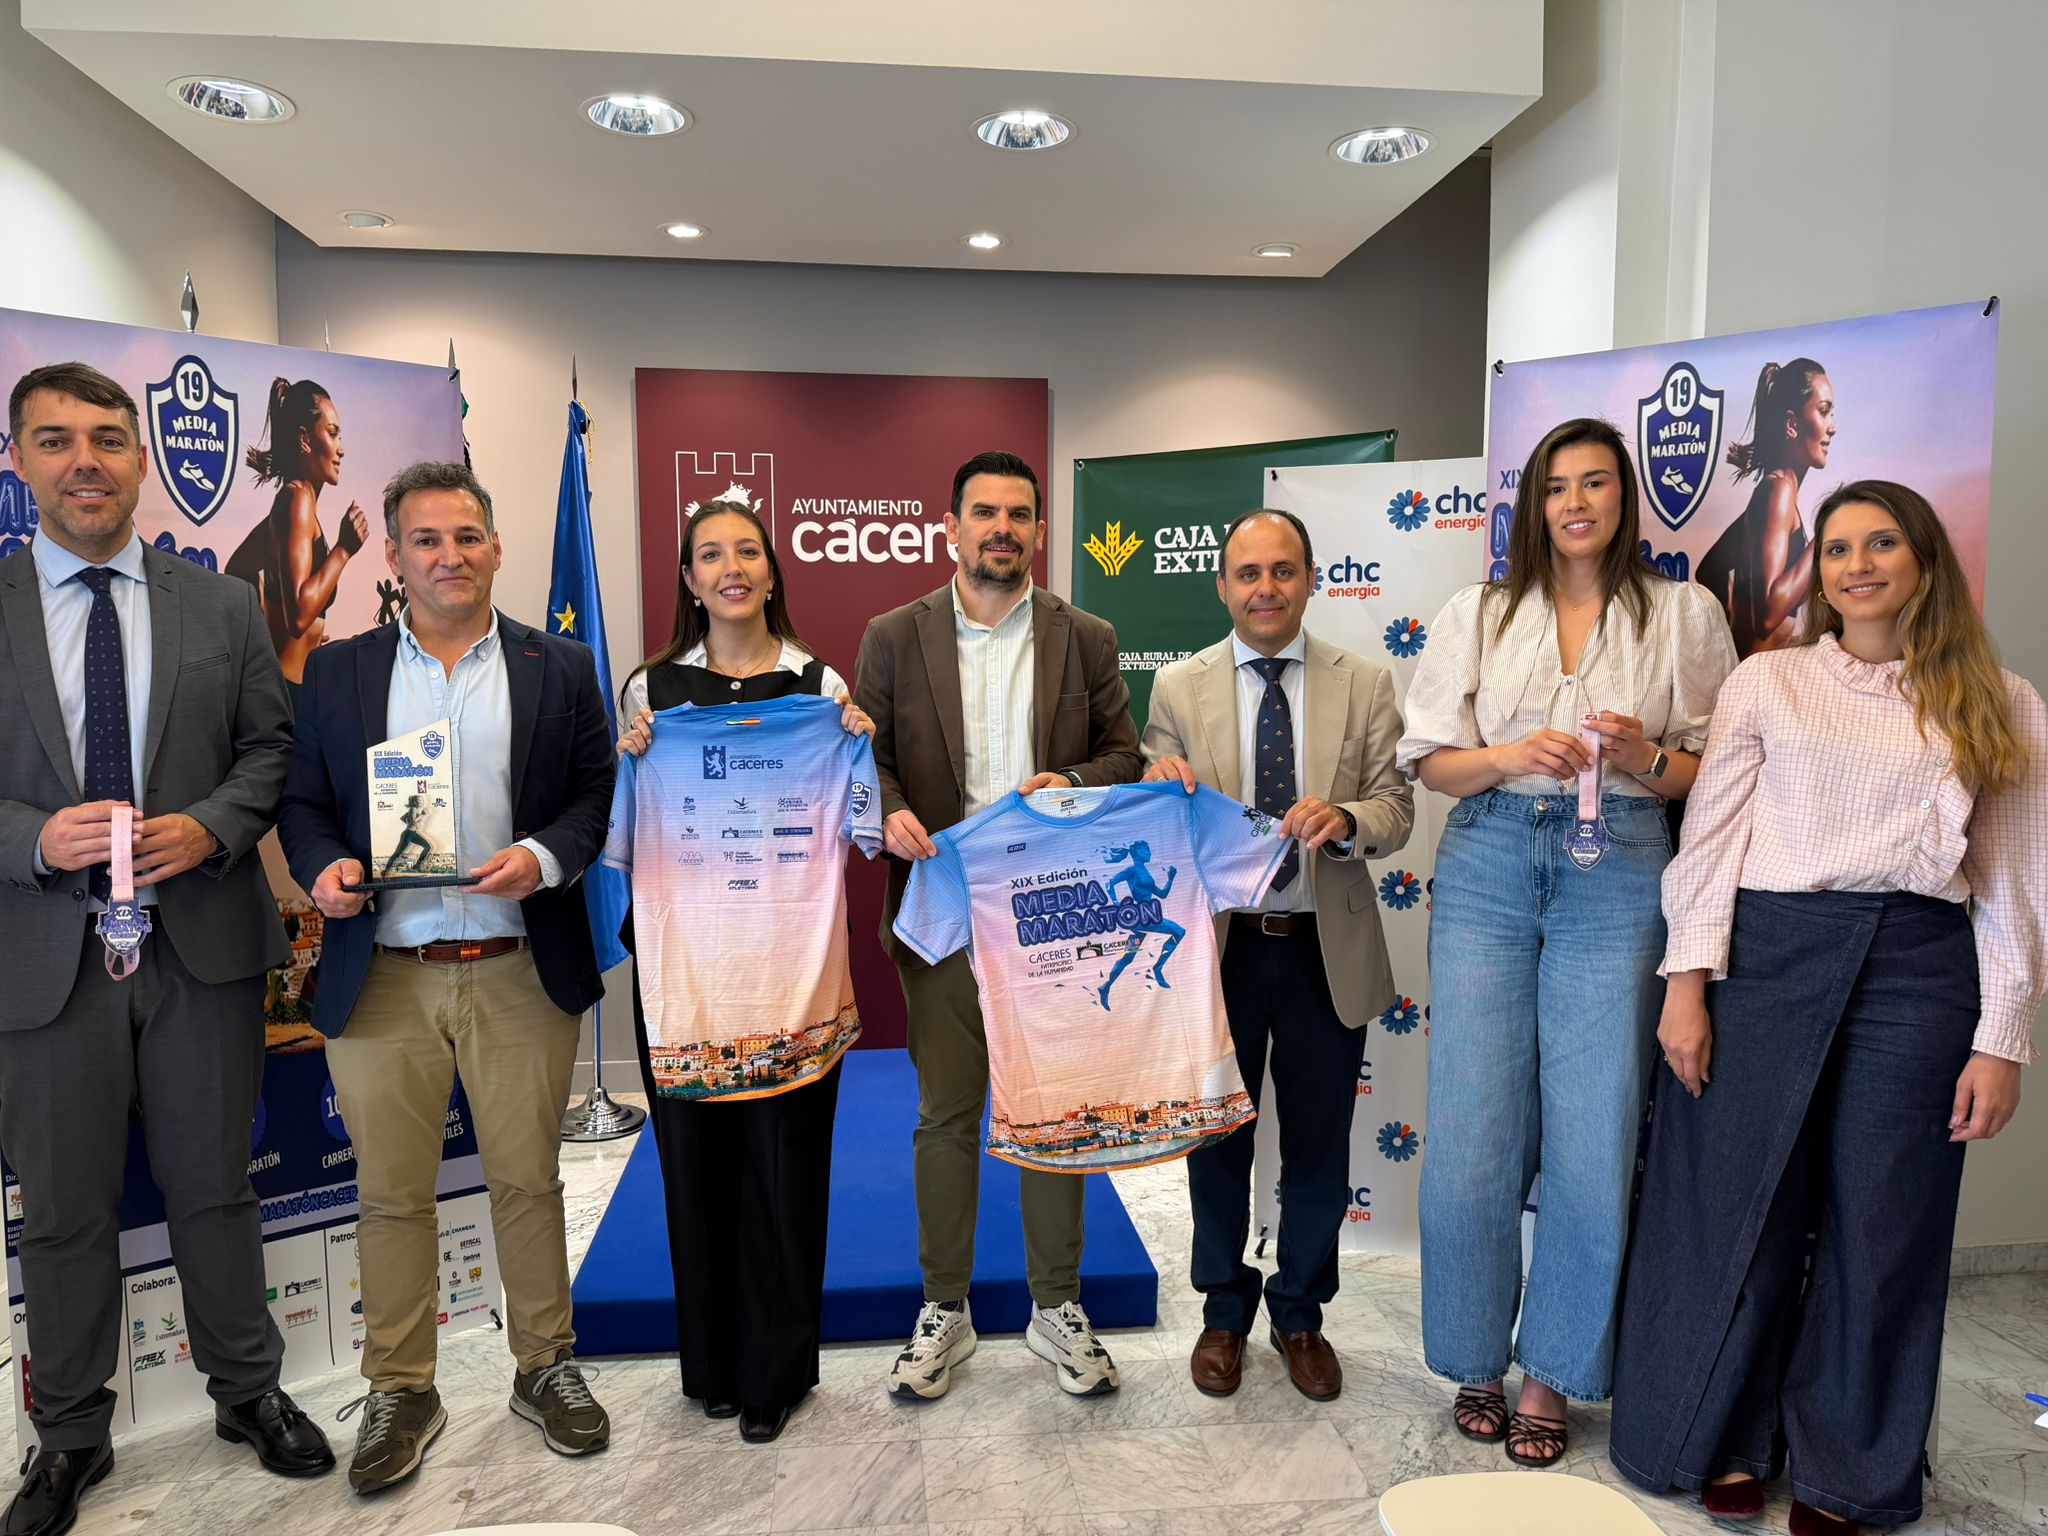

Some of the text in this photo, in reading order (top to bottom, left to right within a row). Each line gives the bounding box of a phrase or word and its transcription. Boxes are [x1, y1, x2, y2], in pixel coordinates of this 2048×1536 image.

[180, 371, 203, 402] 19
[1670, 377, 1691, 407] 19
[172, 415, 218, 437] MEDIA
[1659, 421, 1701, 442] MEDIA
[166, 435, 225, 453] MARATÓN
[1651, 439, 1706, 459] MARATÓN
[791, 498, 923, 517] AYUNTAMIENTO
[1435, 484, 1486, 514] chc
[1154, 525, 1219, 550] CAJA
[1328, 555, 1380, 584] chc
[1327, 583, 1380, 600] energía
[1118, 651, 1193, 661] CAJA RURAL DE
[374, 757, 413, 768] MEDIA
[374, 764, 434, 778] MARATÓN
[1010, 867, 1088, 889] XIX Edición
[1011, 880, 1108, 920] MEDIA
[115, 909, 134, 917] XIX
[1016, 896, 1164, 947] MARATÓN
[1028, 948, 1072, 964] CÁCERES
[1040, 959, 1073, 969] PATRIMONIO
[1044, 966, 1074, 976] HUMANIDAD
[322, 1147, 356, 1169] CARRER
[131, 1276, 176, 1294] Colabora:
[155, 1328, 186, 1341] Extremadura
